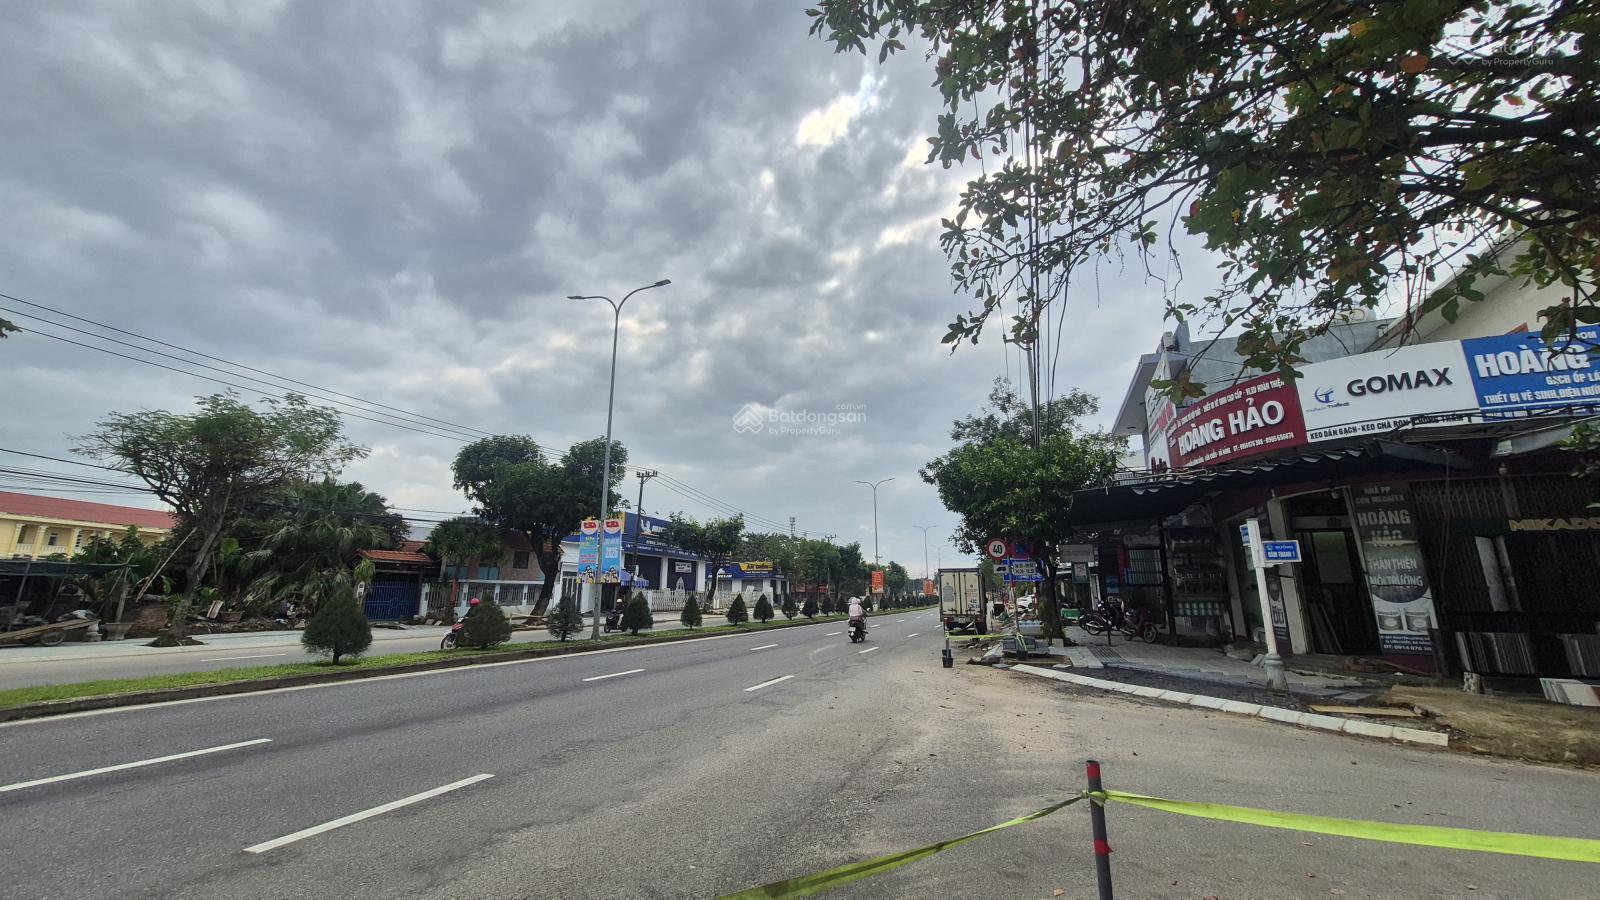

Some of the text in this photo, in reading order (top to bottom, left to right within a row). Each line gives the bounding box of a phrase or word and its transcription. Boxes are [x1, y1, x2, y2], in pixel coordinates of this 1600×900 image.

[1474, 343, 1591, 378] HOÀNG
[1346, 367, 1454, 398] GOMAX
[1545, 373, 1572, 387] GẠCH
[1572, 369, 1586, 383] ỐP
[1483, 390, 1508, 404] THIẾT
[1509, 392, 1520, 404] BỊ
[1177, 417, 1226, 457] HOÀNG
[1227, 396, 1286, 435] HẢO
[1310, 431, 1323, 440] KEO
[1323, 428, 1338, 438] DÁN
[1361, 422, 1376, 432] KEO
[1356, 507, 1411, 527] HOÀNG
[992, 544, 1003, 554] 40
